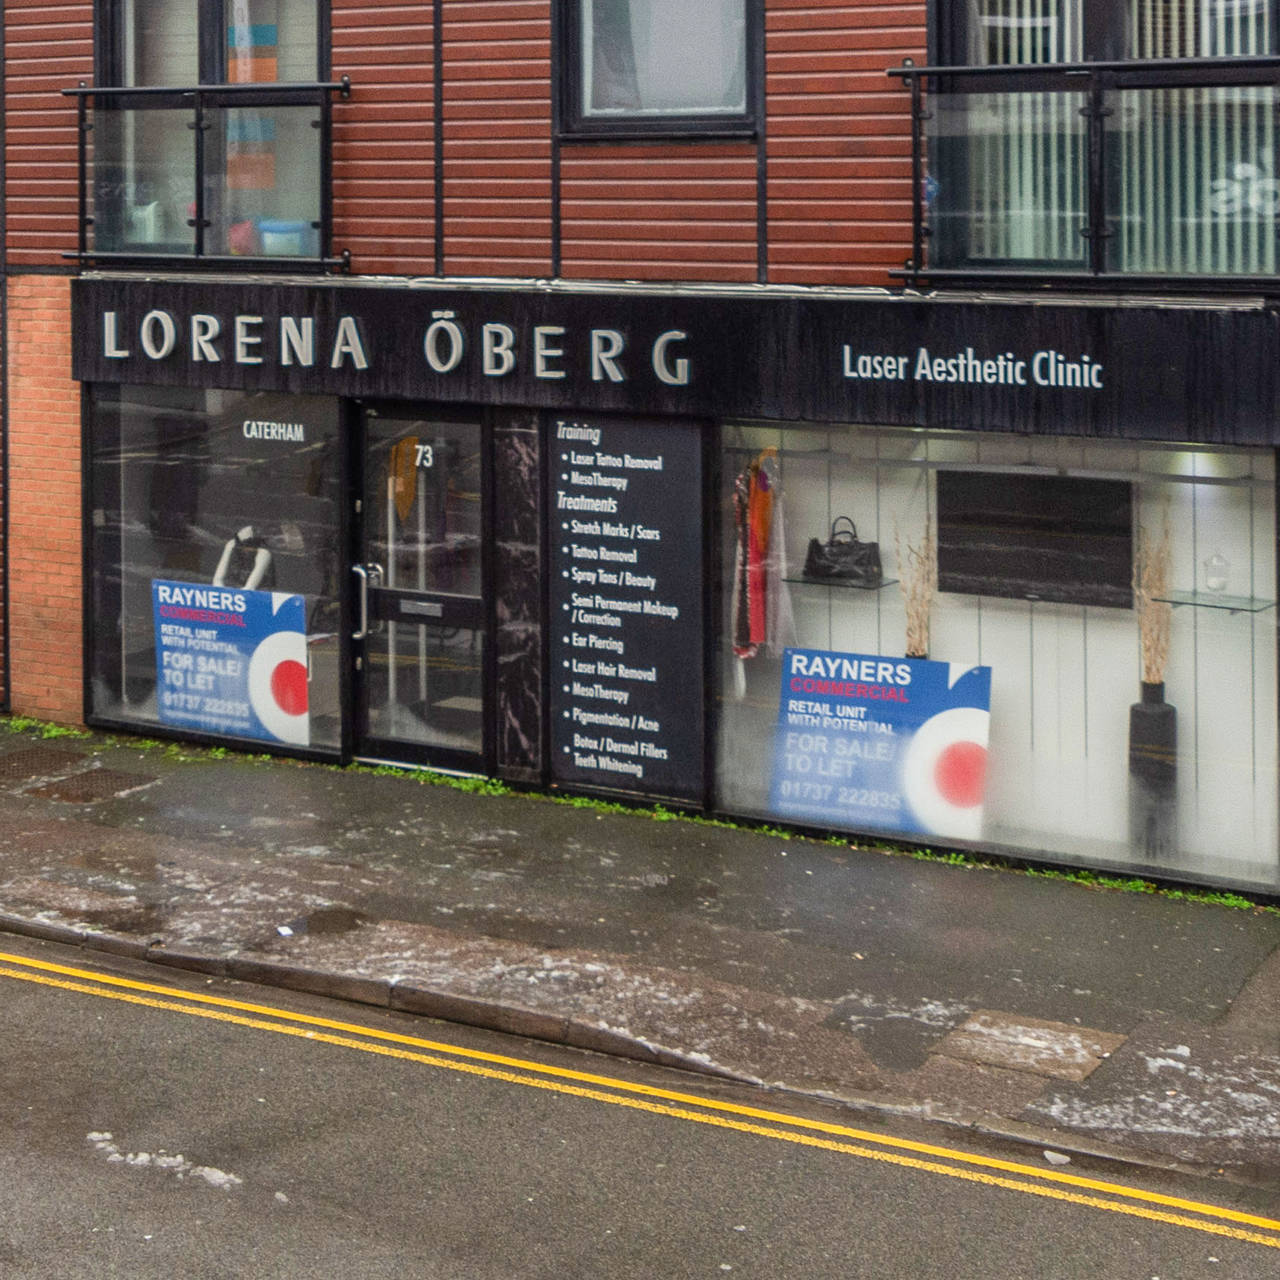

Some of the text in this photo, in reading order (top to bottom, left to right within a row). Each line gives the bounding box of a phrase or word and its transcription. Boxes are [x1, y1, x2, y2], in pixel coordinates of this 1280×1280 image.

[103, 309, 692, 385] LORENA ÖBERG
[843, 344, 1104, 389] Laser Aesthetic Clinic
[243, 420, 305, 442] CATERHAM
[556, 421, 601, 446] Training
[414, 444, 434, 467] 73
[570, 450, 663, 471] Laser Tattoo Removal
[570, 471, 628, 491] MesoTherapy
[557, 490, 618, 513] Treatments
[570, 519, 601, 535] Stretch
[602, 521, 629, 538] Marks
[636, 524, 661, 540] Scars
[571, 543, 638, 563] Tattoo Removal
[571, 566, 597, 585] Spray
[597, 568, 618, 584] Tans
[625, 571, 657, 591] Beauty
[158, 586, 246, 612] RAYNERS
[571, 592, 679, 620] Semi Permanent Makeup
[160, 605, 246, 627] COMMERCIAL
[578, 609, 622, 627] Correction
[161, 624, 217, 640] RETAIL UNIT
[572, 632, 624, 655] Ear Piercing
[161, 636, 239, 654] WITH POTENTIAL
[163, 651, 194, 669] FOR
[572, 658, 657, 682] Laser Hair Removal
[791, 654, 912, 686] RAYNERS
[163, 669, 215, 690] TO LET
[790, 677, 910, 703] COMMERCIAL
[572, 681, 629, 705] MesoTherapy
[572, 707, 630, 728] Pigmentation
[637, 715, 659, 732] Acne
[788, 699, 867, 719] RETAIL UNIT
[788, 713, 897, 736] WITH POTENTIAL
[573, 733, 599, 750] Botox
[606, 738, 639, 756] Dermal
[640, 742, 668, 760] Fillers
[786, 733, 828, 754] FOR
[573, 752, 643, 779] Teeth Whitening
[785, 753, 857, 778] TO LET
[780, 781, 833, 801] 01737
